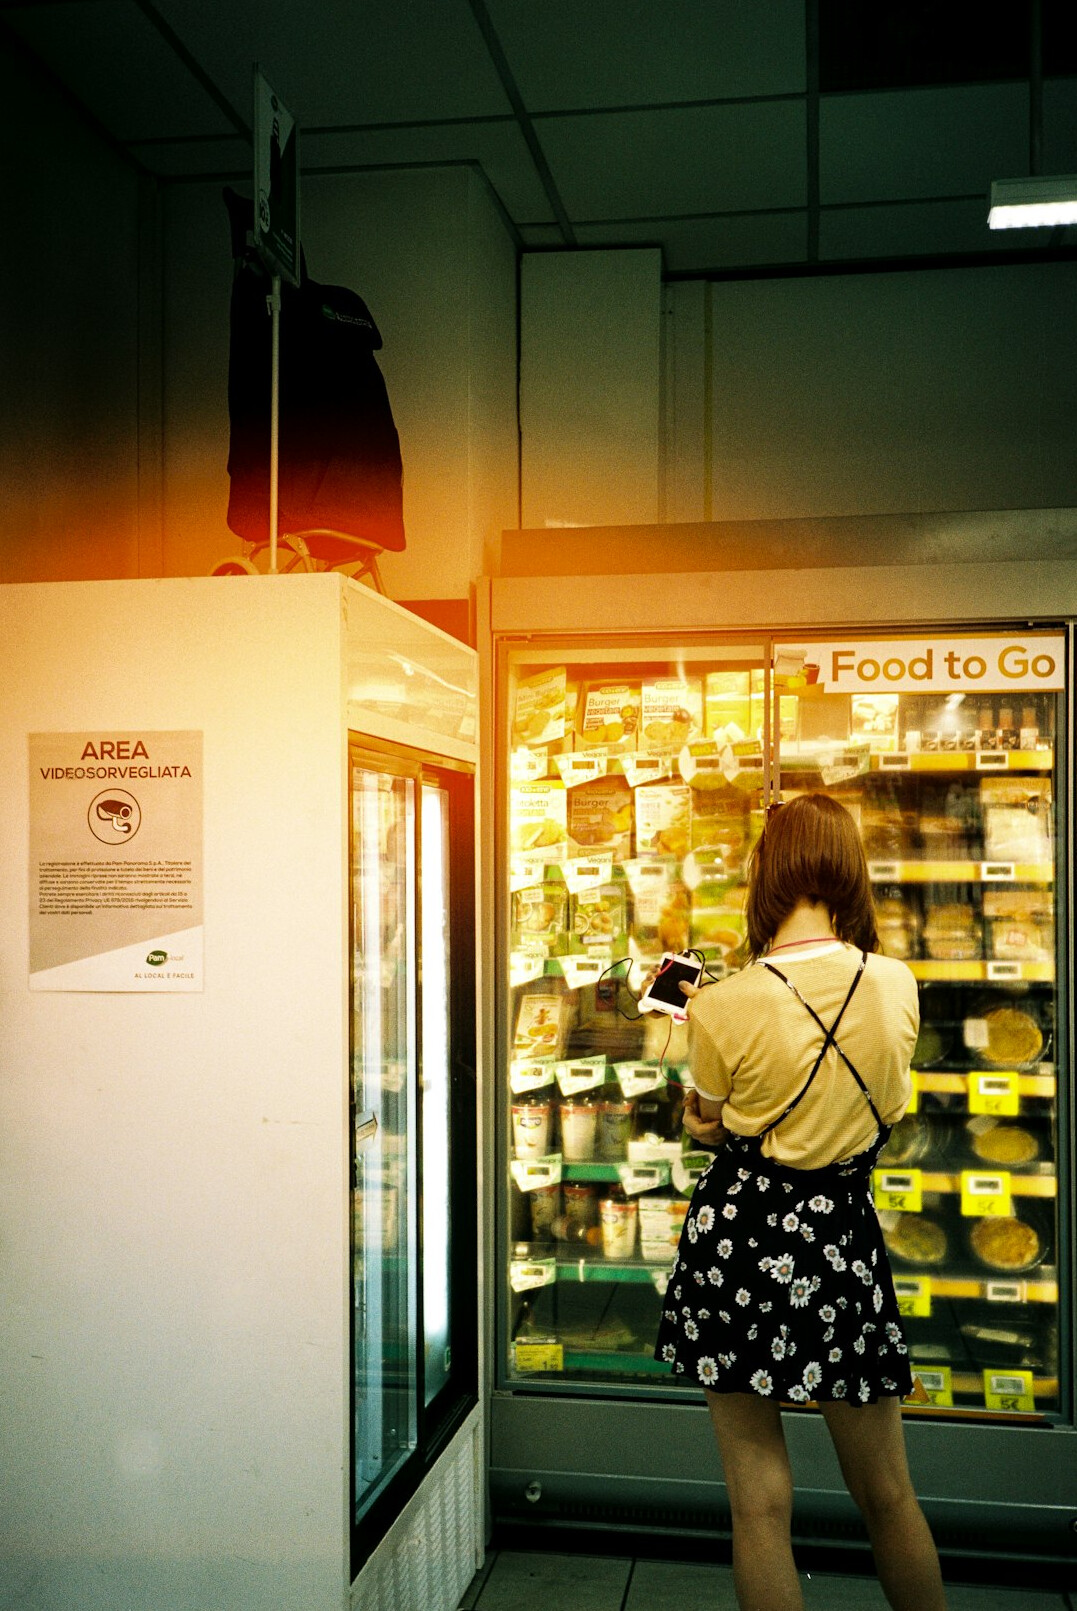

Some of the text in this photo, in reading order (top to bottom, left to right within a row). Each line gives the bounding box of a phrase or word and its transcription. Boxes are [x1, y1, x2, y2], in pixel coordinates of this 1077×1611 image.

[831, 645, 1056, 682] Food to Go
[588, 698, 620, 707] Burger
[644, 694, 680, 705] Burger
[81, 741, 149, 760] AREA
[39, 766, 192, 780] VIDEOSORVEGLIATA
[574, 798, 609, 809] Burger
[148, 954, 165, 962] Pam
[134, 972, 143, 980] AL
[144, 972, 165, 980] LOCAL
[173, 972, 195, 980] FACILE
[889, 1193, 906, 1209] 5€
[978, 1201, 995, 1214] 5€
[1001, 1397, 1020, 1412] 5€
